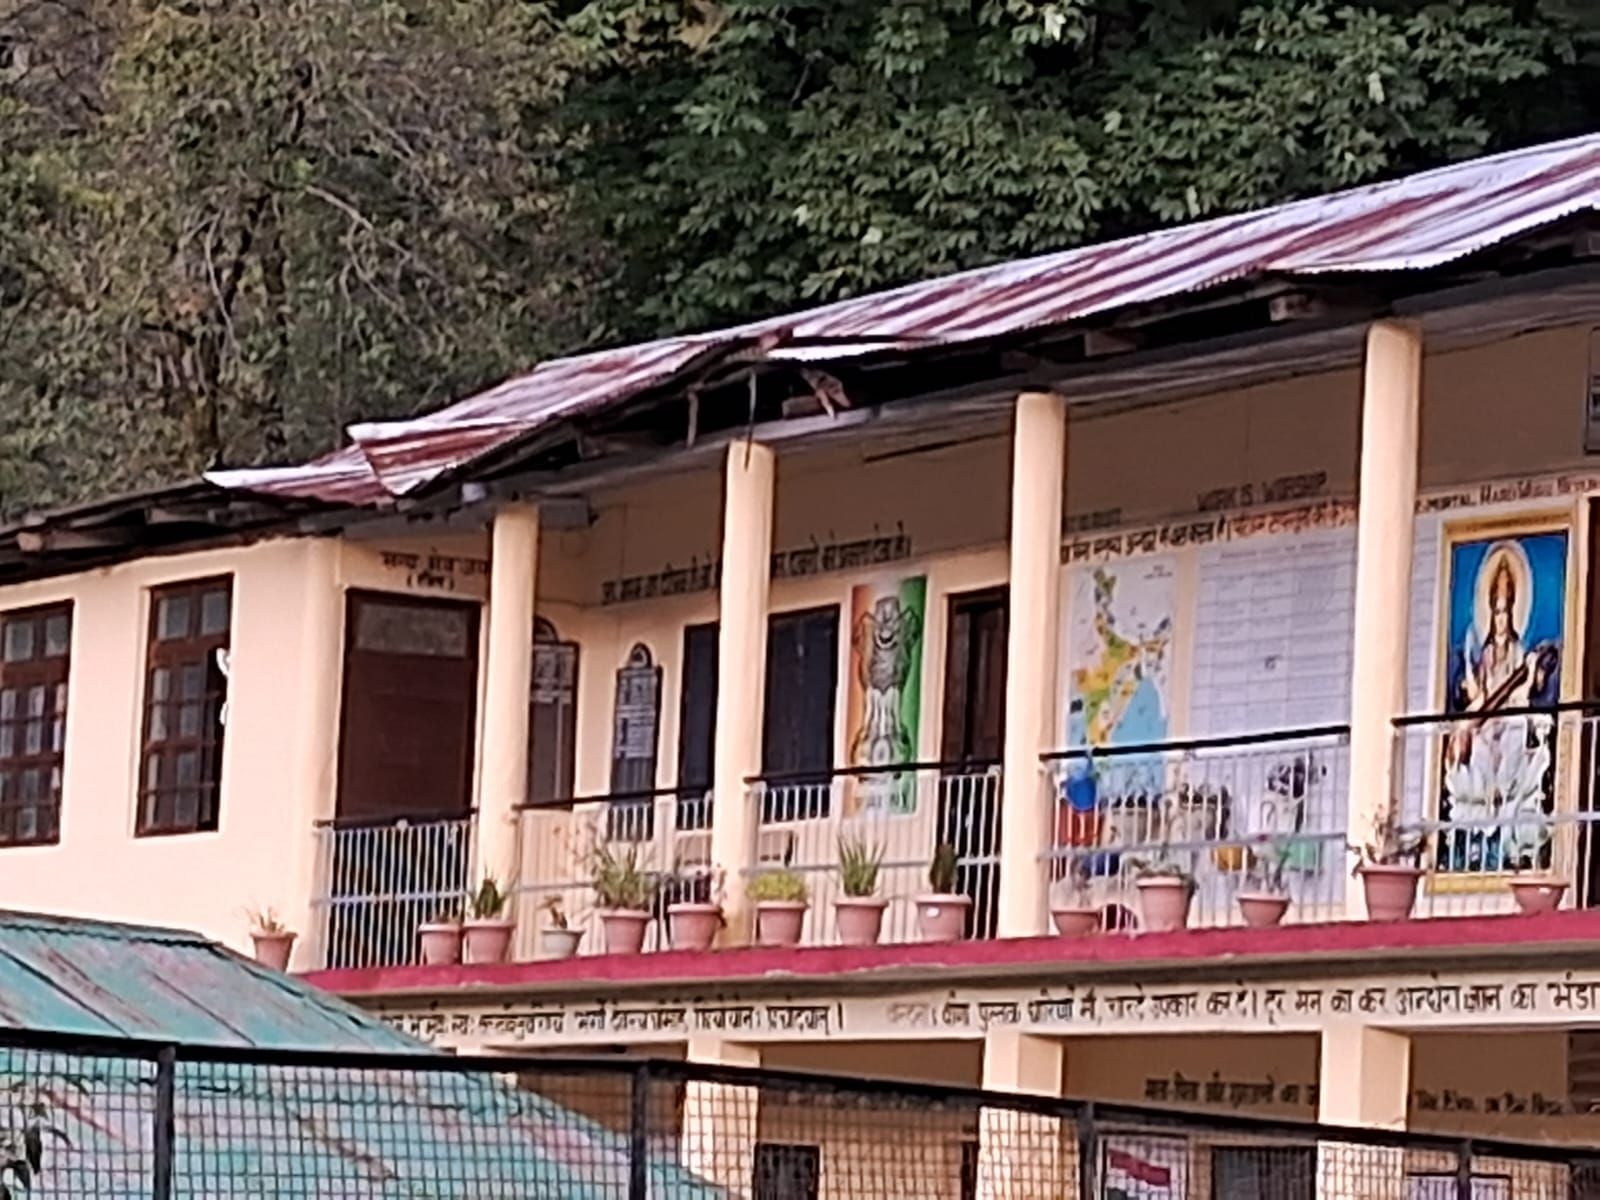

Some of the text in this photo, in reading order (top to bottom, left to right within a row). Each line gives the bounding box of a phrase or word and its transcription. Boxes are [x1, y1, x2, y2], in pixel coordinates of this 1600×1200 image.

[1295, 989, 1323, 1014] मन
[1330, 988, 1354, 1013] का
[1547, 970, 1600, 1010] भंडा
